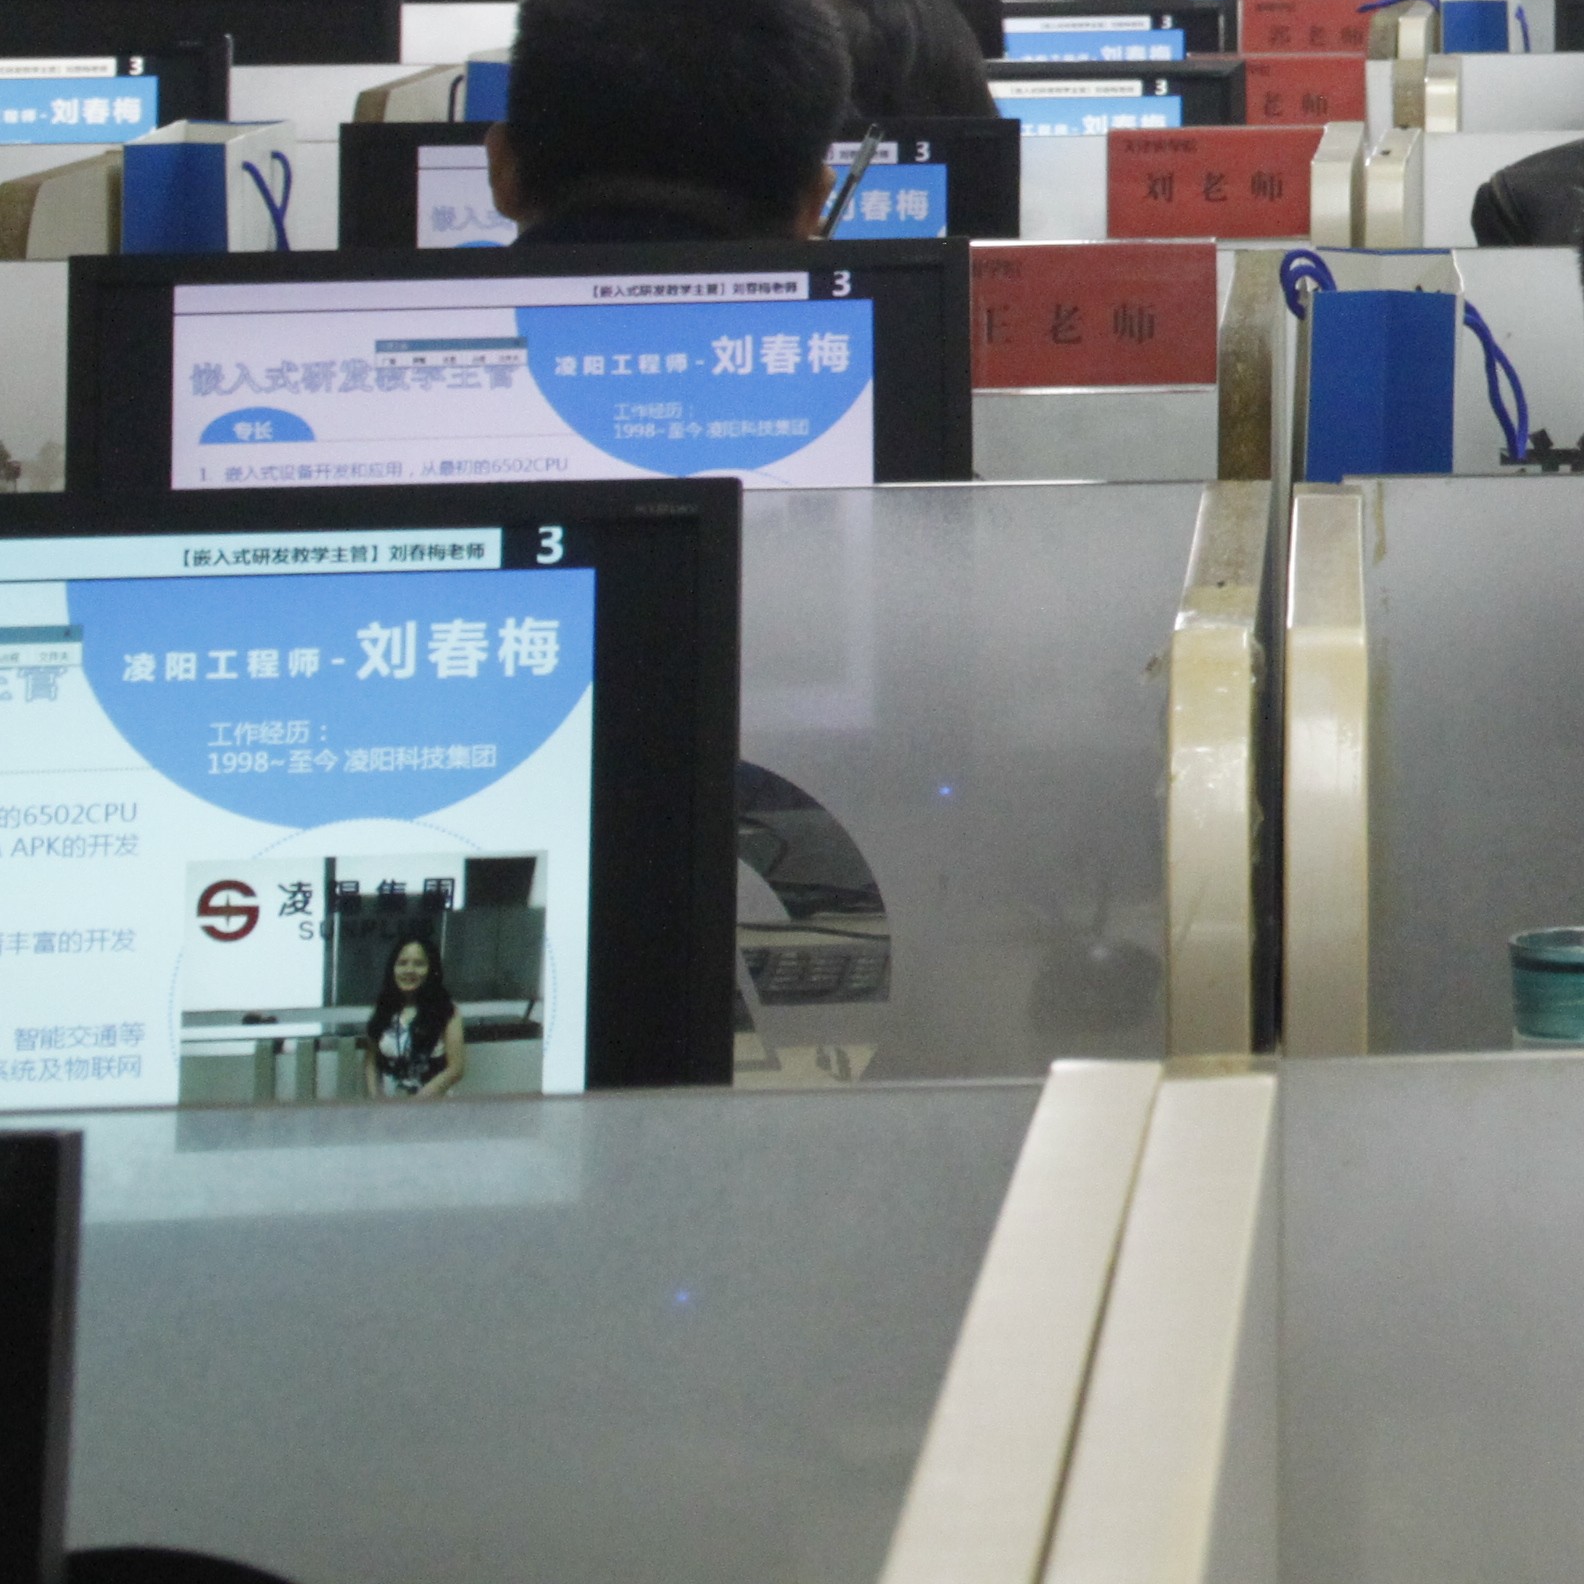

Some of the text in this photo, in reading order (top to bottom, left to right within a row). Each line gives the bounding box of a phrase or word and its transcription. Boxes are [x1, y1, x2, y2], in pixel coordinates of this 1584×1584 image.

[129, 56, 144, 76] 3
[1155, 78, 1169, 96] 3
[914, 141, 931, 162] 3
[1146, 170, 1284, 203] 刘老师
[831, 270, 853, 298] 3
[554, 330, 851, 377] 凌阳工程师-刘春梅
[232, 420, 274, 442] 专长
[535, 526, 565, 565] 3
[122, 615, 561, 683] 凌阳工程师-刘春梅
[344, 744, 498, 773] 凌阳科技集团
[10, 833, 140, 859] APK的开发
[0, 927, 137, 957] 丰富的开发
